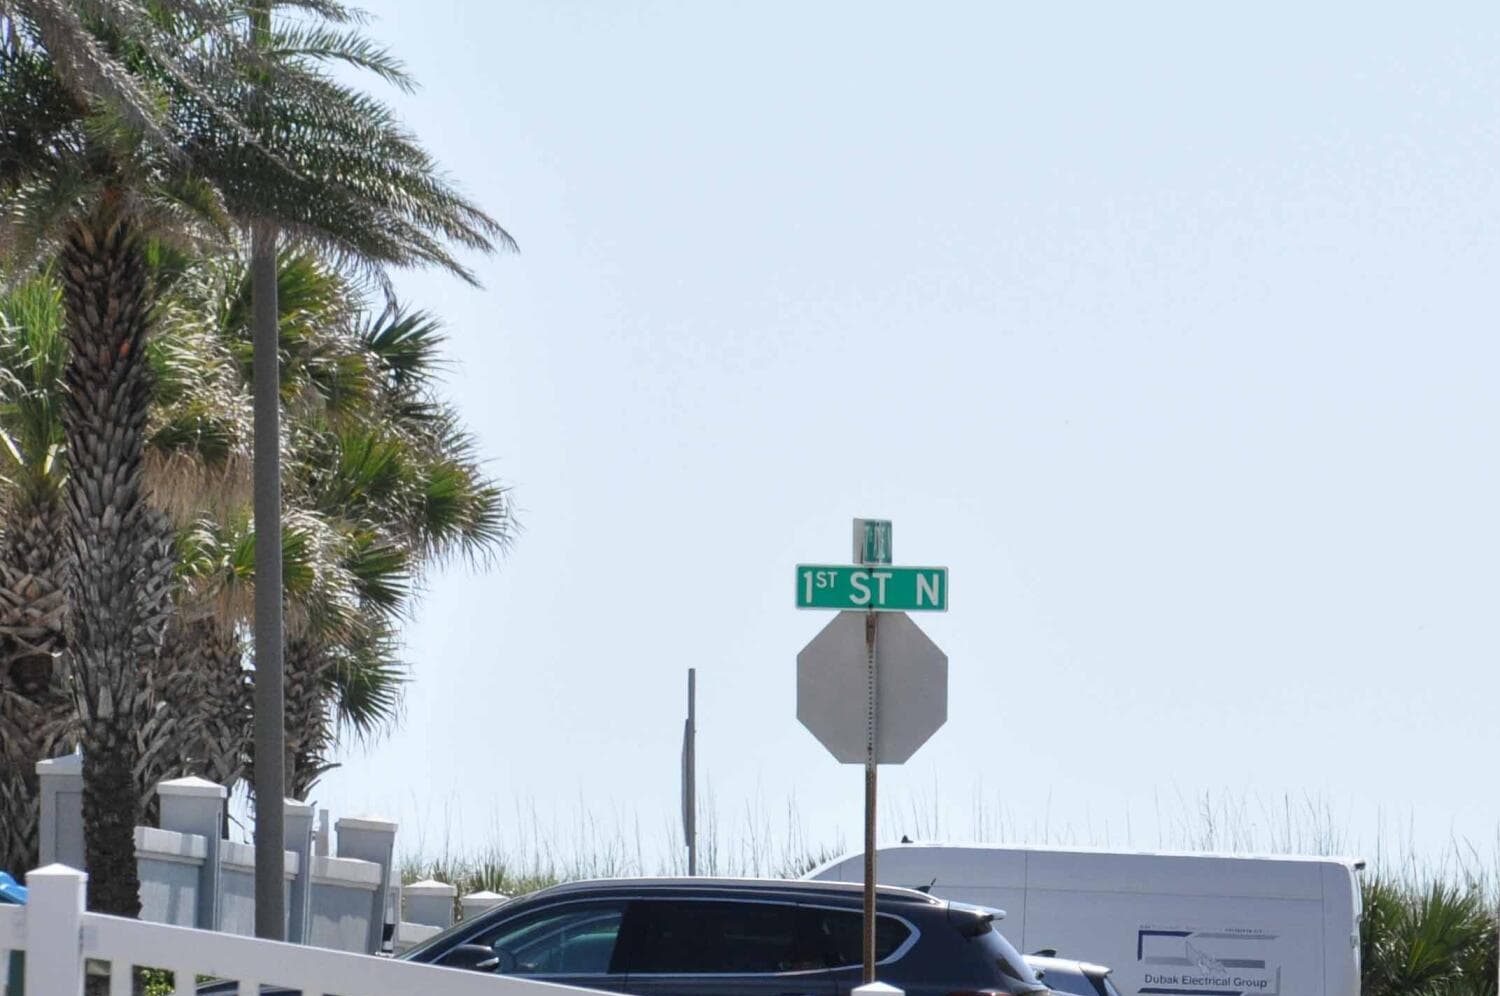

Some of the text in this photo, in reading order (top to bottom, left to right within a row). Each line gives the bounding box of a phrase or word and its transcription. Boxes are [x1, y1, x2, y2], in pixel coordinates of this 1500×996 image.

[803, 571, 939, 606] 1ST ST N
[1144, 973, 1268, 989] Dubak Electrical Group
